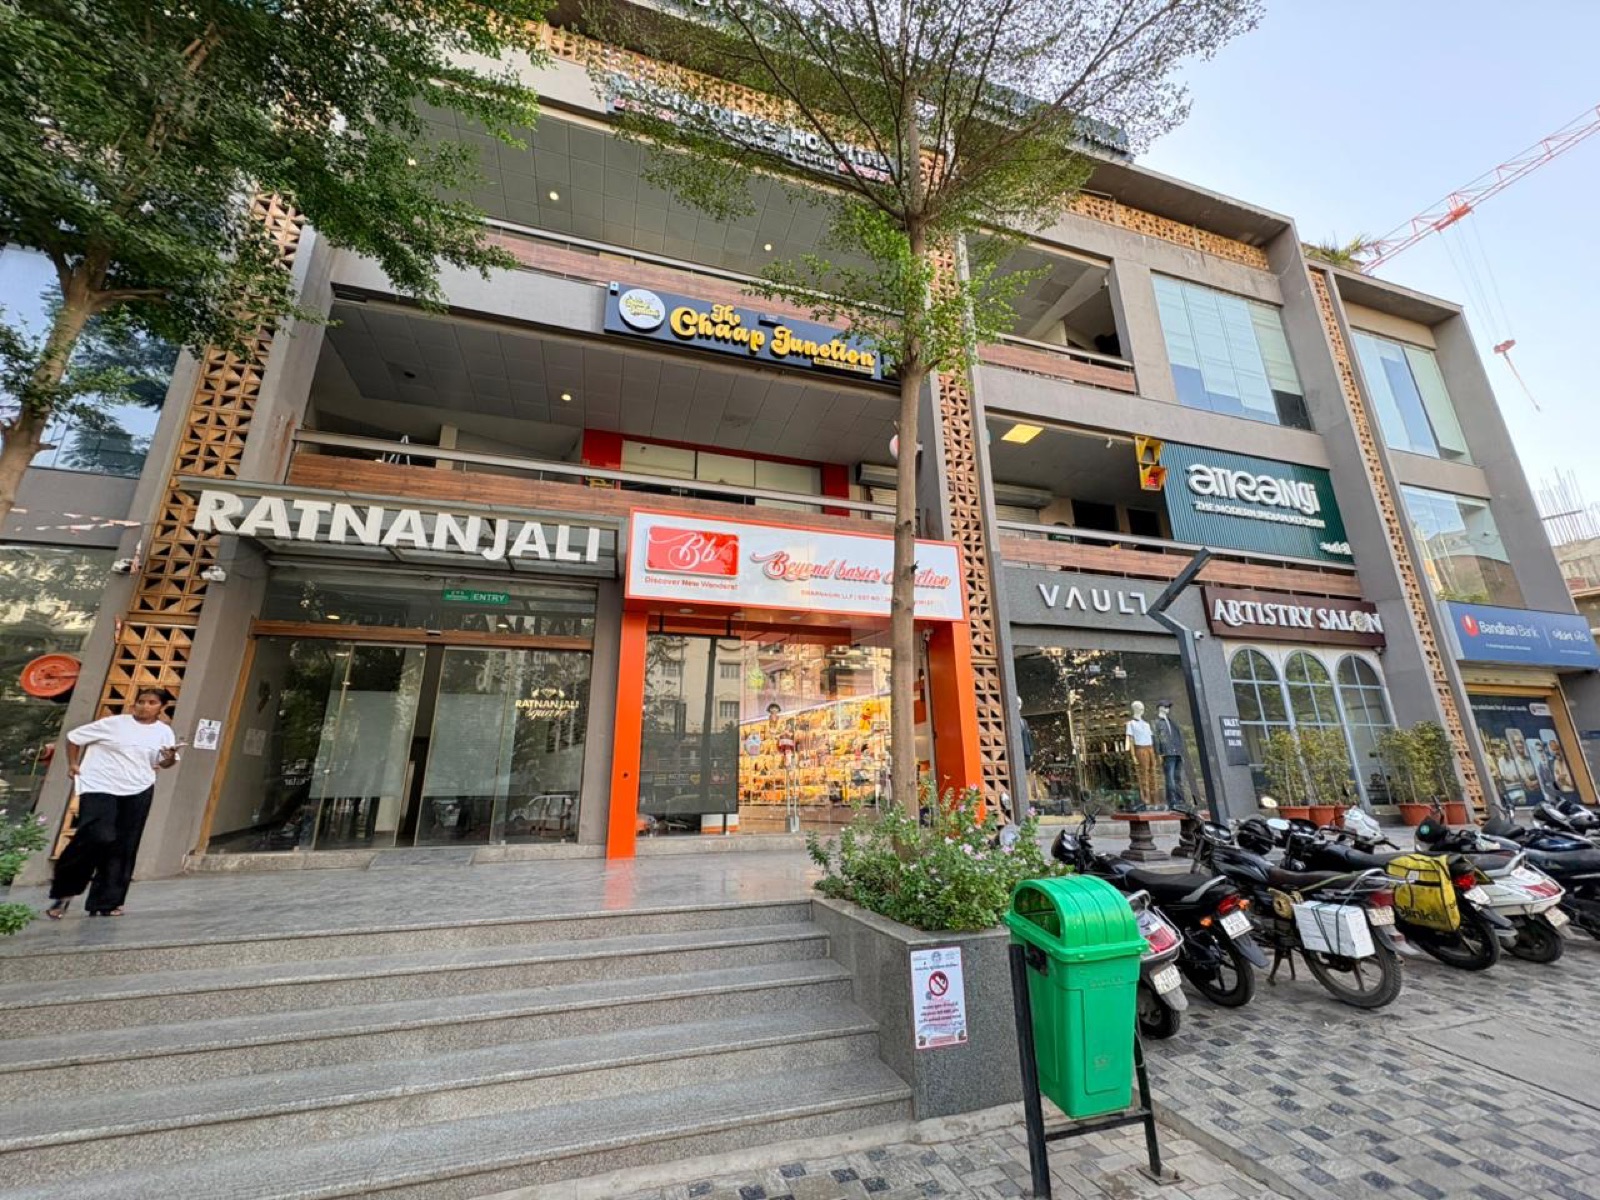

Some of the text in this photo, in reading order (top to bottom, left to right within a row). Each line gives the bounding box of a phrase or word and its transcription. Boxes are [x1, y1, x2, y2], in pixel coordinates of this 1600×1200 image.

[711, 304, 741, 326] The
[670, 306, 766, 352] Chaap
[770, 325, 876, 367] Junction
[192, 489, 600, 563] RATNANJALI
[750, 550, 834, 581] Beyond
[836, 560, 881, 583] basics
[682, 579, 699, 587] New
[473, 593, 506, 602] ENTRY
[1038, 583, 1148, 616] VAULT
[1213, 598, 1385, 634] ARTISTRY SALON
[1479, 620, 1518, 637] Bandhan
[515, 699, 580, 710] RATNANJALI
